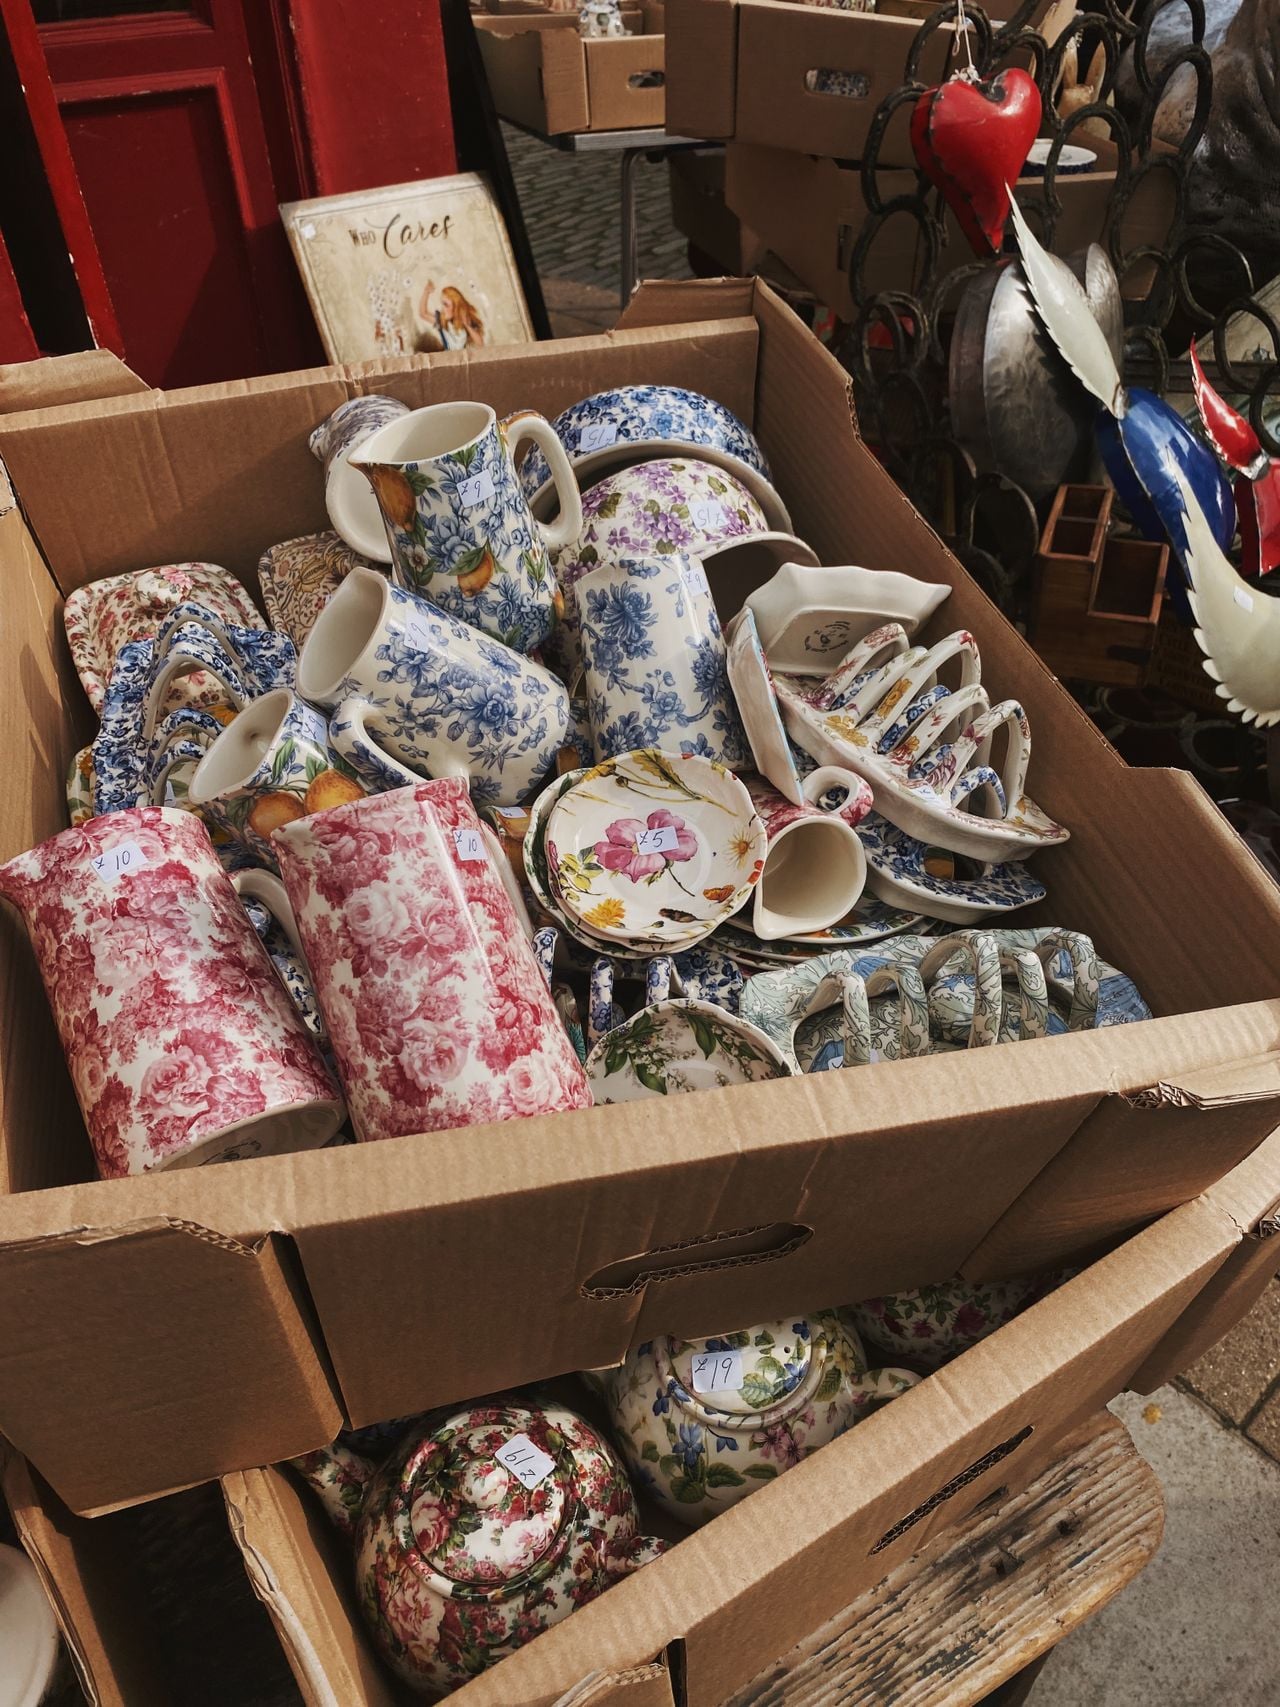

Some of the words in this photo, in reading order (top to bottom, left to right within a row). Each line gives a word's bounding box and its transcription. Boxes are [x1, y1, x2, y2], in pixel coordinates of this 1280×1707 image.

[364, 213, 455, 259] Cares
[640, 830, 665, 848] £5
[694, 1357, 733, 1389] £19
